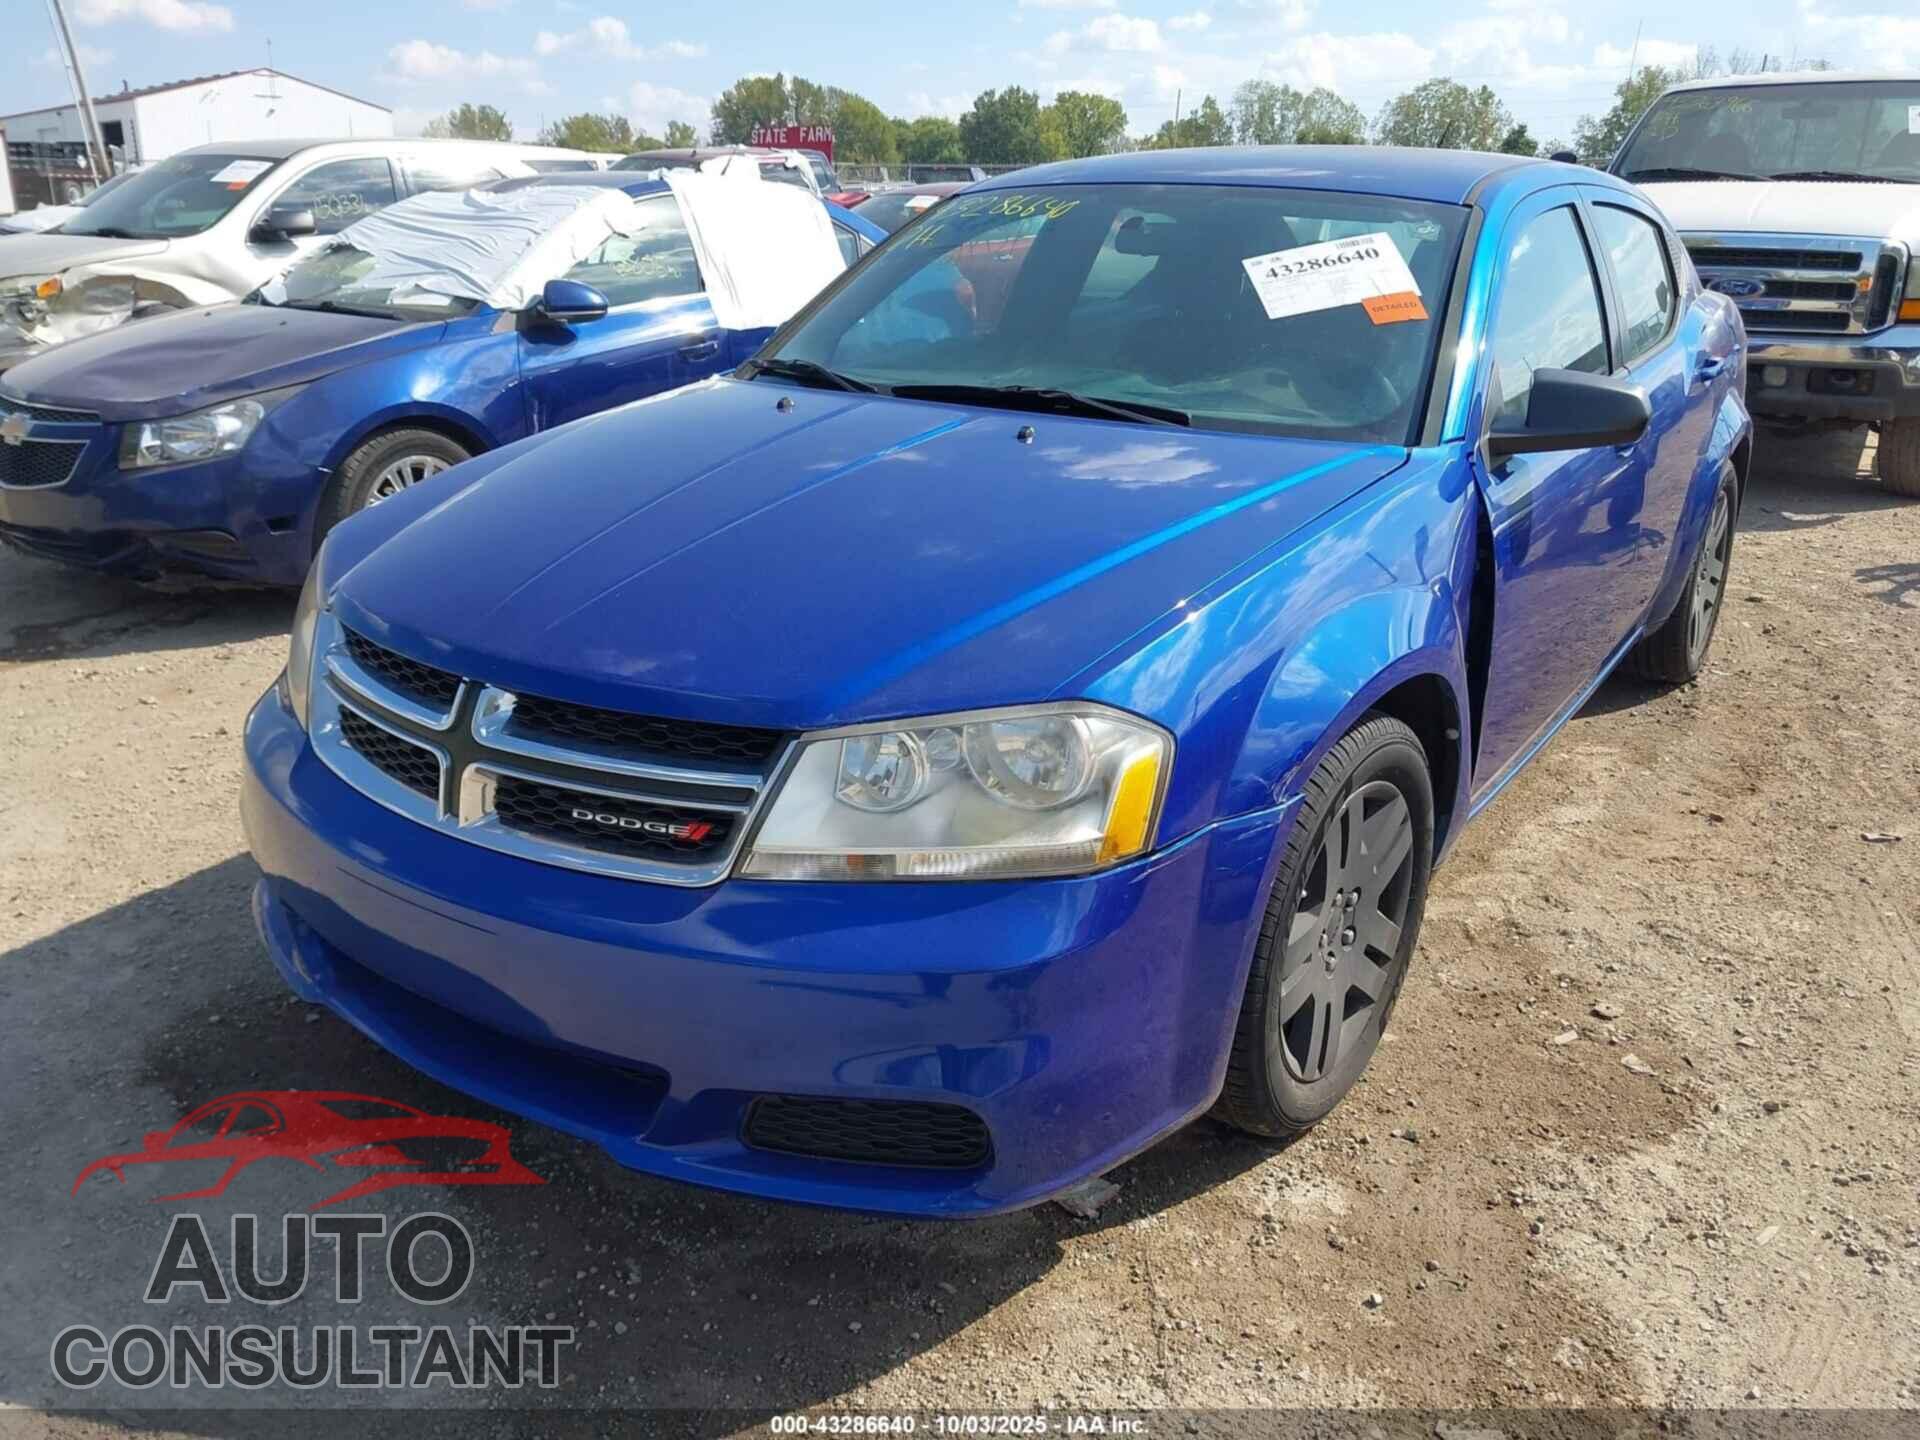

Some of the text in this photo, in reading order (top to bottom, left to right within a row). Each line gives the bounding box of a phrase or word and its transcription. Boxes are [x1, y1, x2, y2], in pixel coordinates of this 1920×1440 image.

[751, 126, 833, 145] STATE FARM
[1265, 247, 1380, 280] 43286640
[1371, 302, 1418, 313] DETAILED
[571, 808, 691, 837] DODGE
